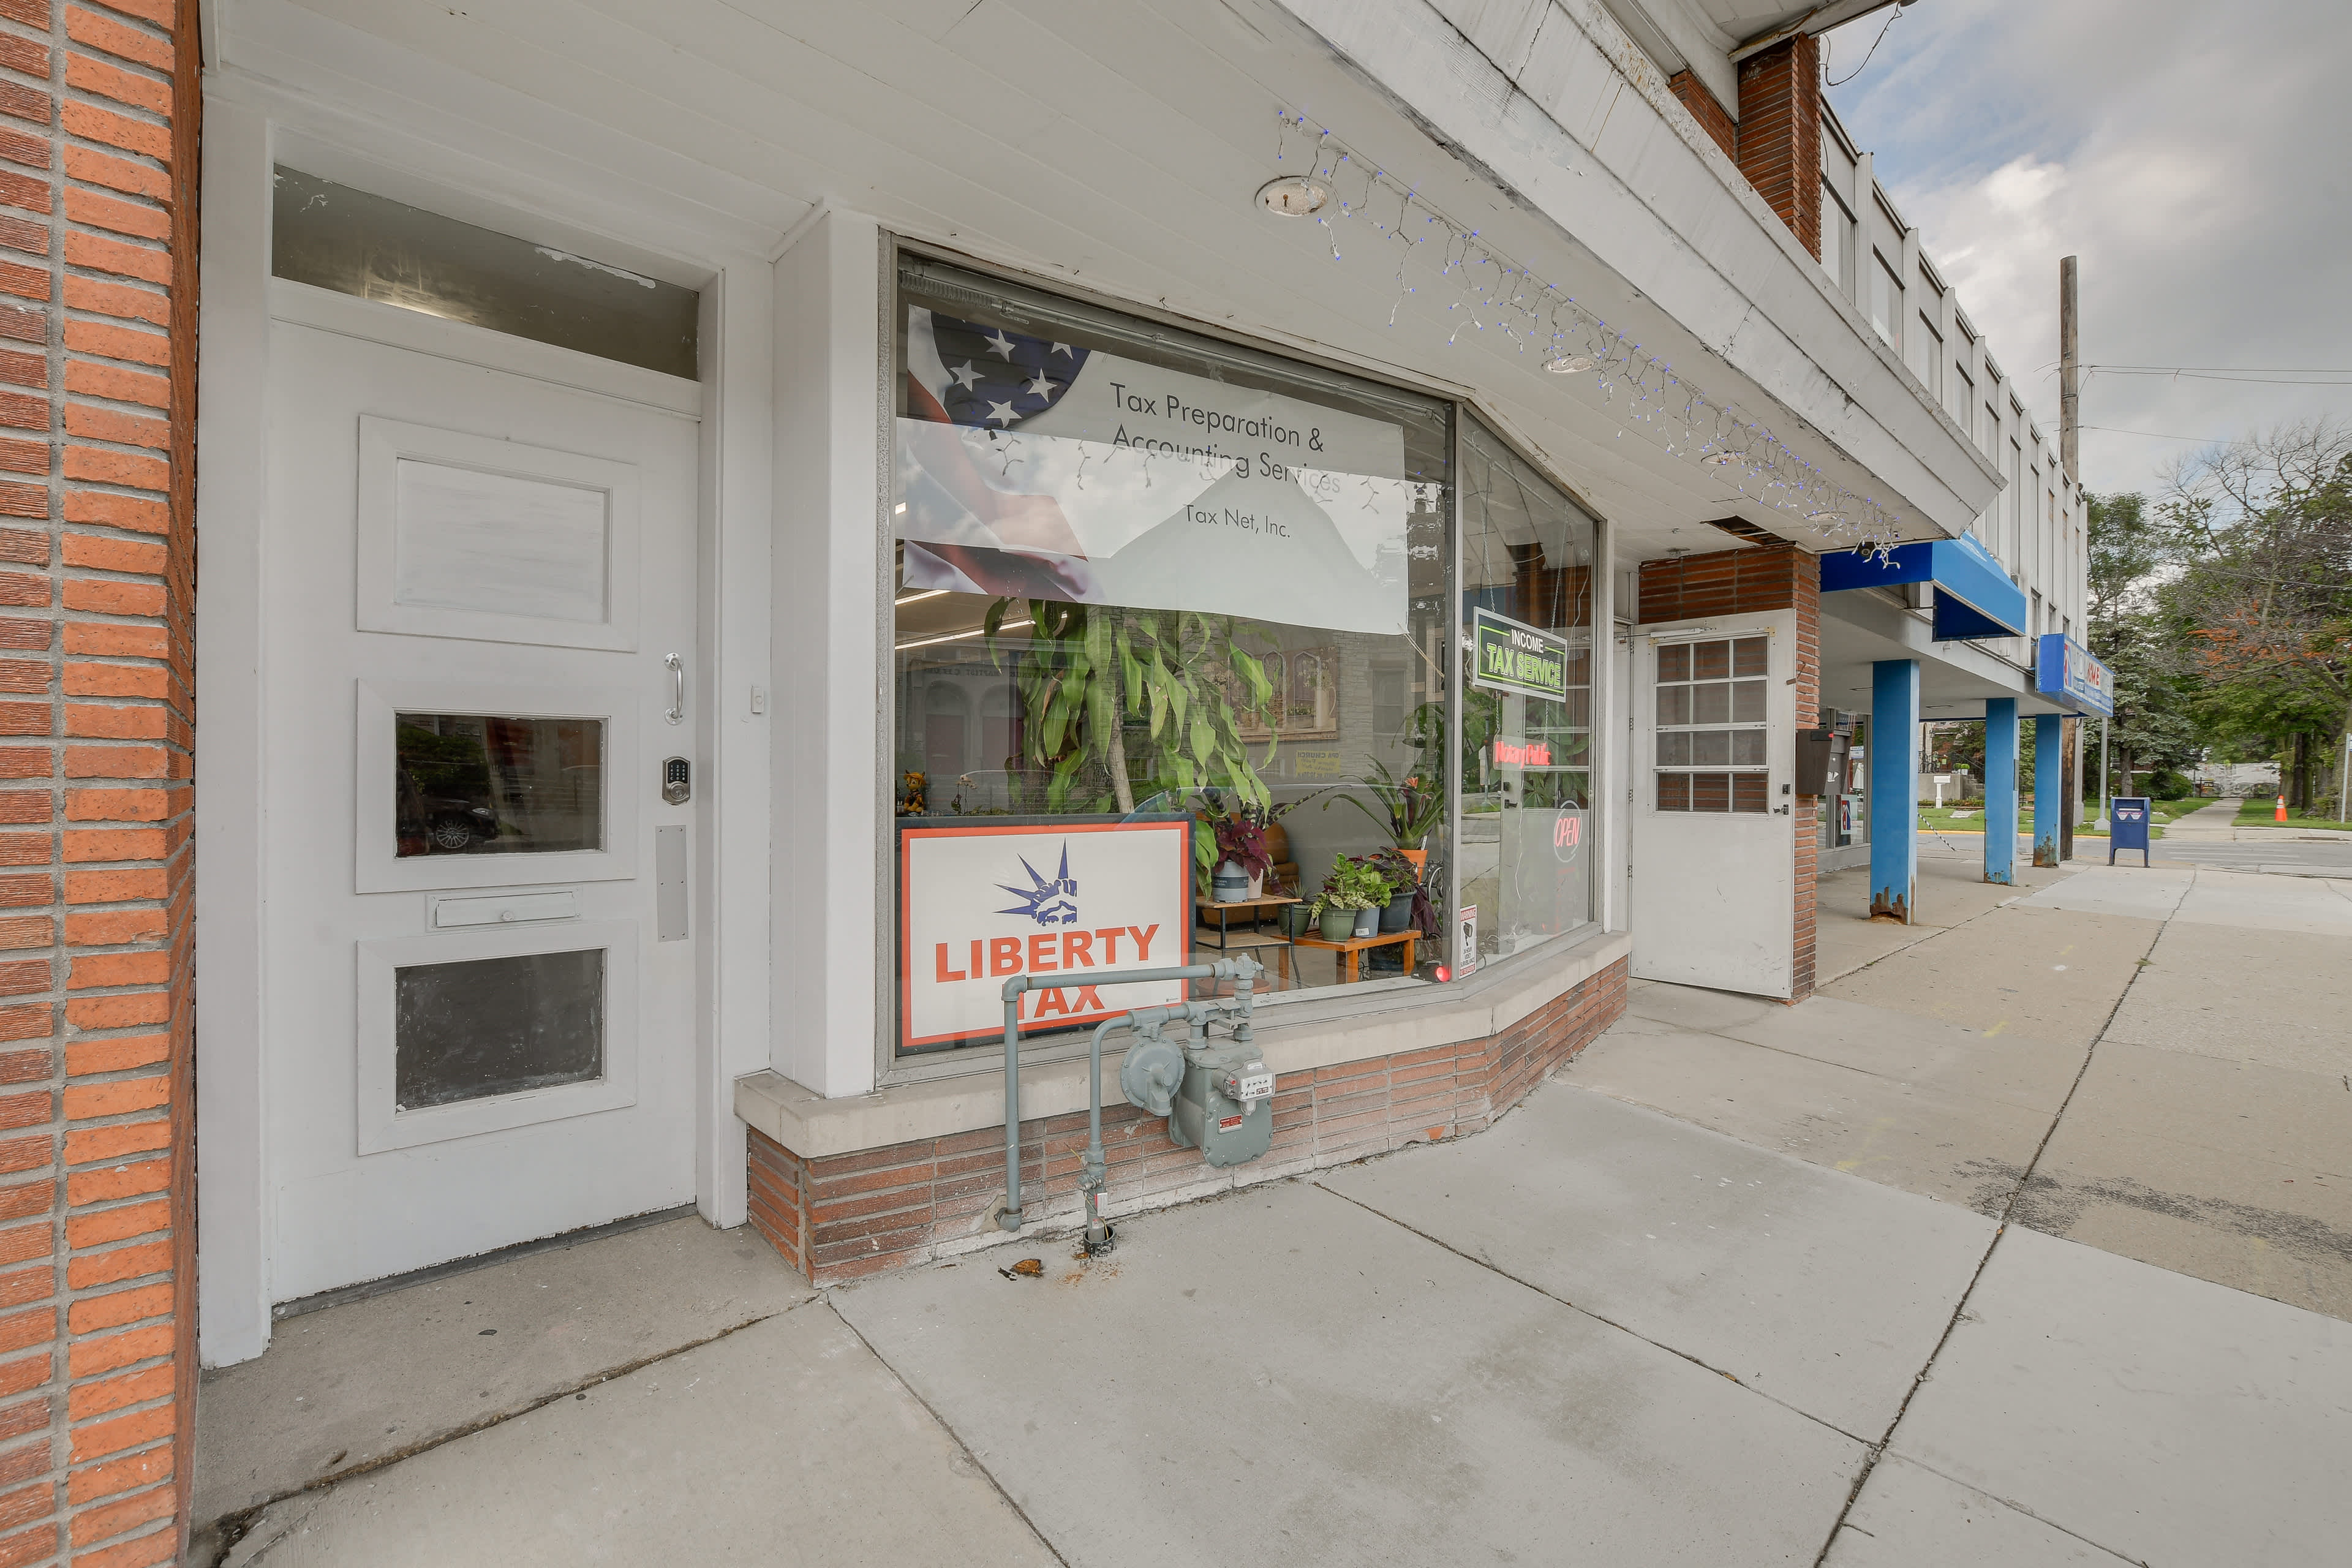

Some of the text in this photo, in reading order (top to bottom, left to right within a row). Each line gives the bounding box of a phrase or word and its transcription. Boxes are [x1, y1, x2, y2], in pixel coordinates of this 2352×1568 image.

[1110, 382, 1324, 453] Tax Preparation &
[1112, 423, 1341, 494] Accounting Services
[1184, 504, 1291, 538] Tax Net, Inc.
[1511, 628, 1544, 654] INCOME
[1487, 643, 1561, 688] TAX SERVICE
[1494, 741, 1551, 769] Notary Public
[1555, 816, 1580, 847] OPEN
[935, 924, 1160, 983] LIBERTY
